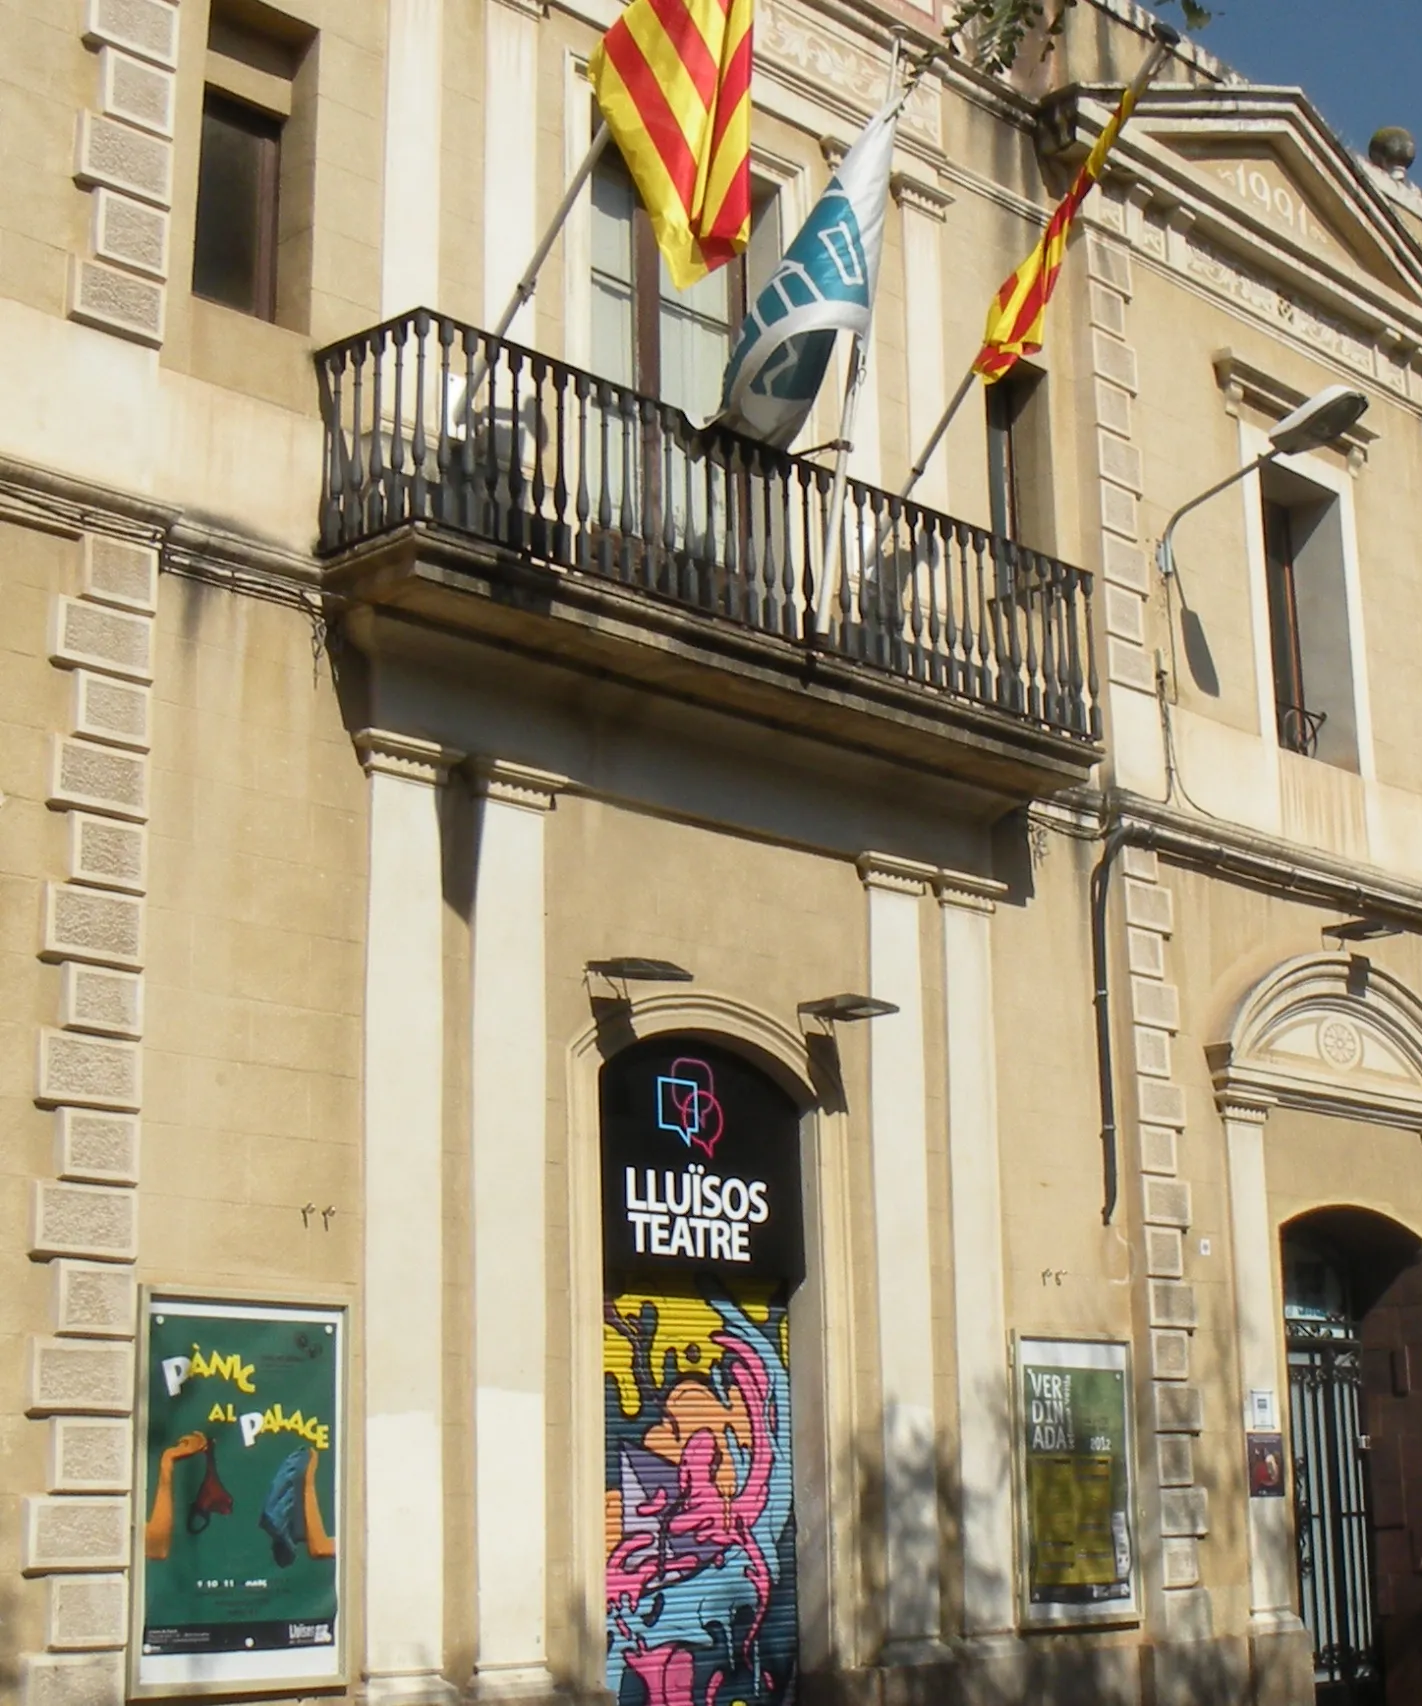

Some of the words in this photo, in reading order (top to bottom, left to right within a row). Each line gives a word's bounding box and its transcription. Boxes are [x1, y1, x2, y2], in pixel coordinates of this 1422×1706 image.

[1236, 164, 1308, 235] 1991
[625, 1164, 769, 1223] LLUÏSOS
[627, 1213, 751, 1262] TEATRE
[162, 1343, 256, 1396] PÀNIC
[1031, 1373, 1063, 1399] VER
[208, 1403, 237, 1422] AL
[240, 1403, 329, 1449] PALACE
[1032, 1400, 1064, 1424] DIN
[1032, 1425, 1067, 1450] ADA
[206, 1579, 219, 1588] 10
[223, 1579, 235, 1588] 11
